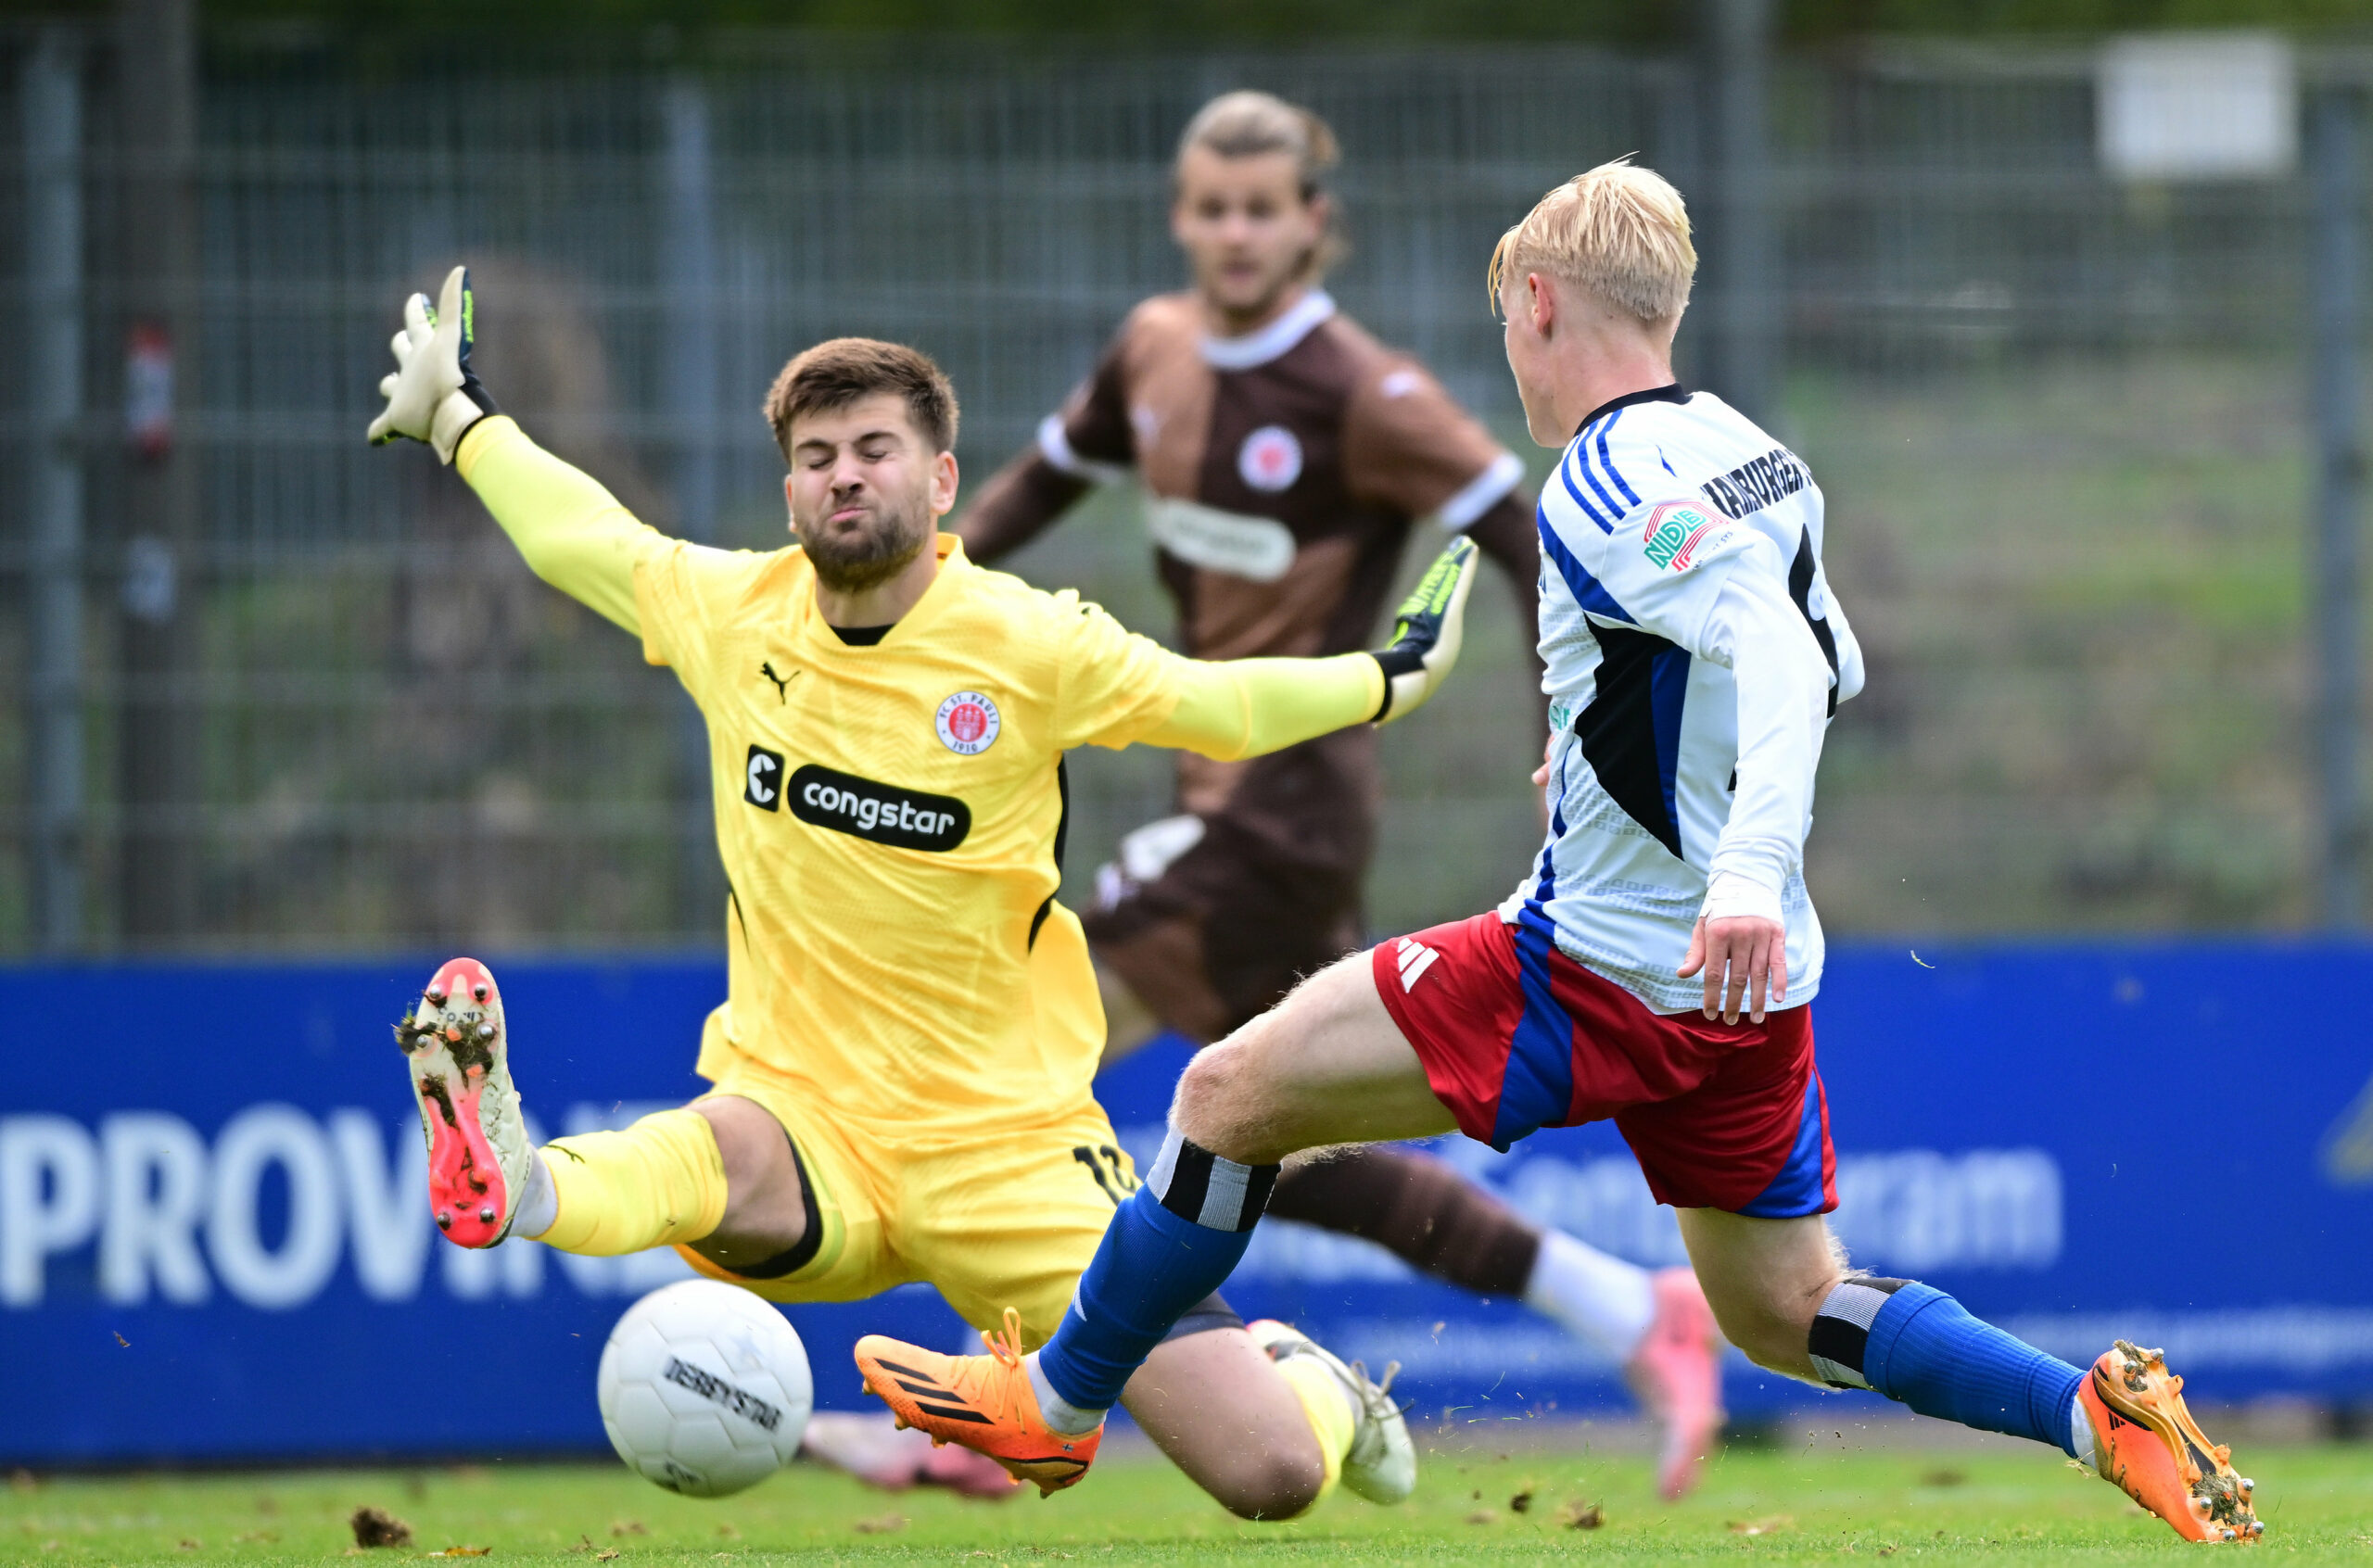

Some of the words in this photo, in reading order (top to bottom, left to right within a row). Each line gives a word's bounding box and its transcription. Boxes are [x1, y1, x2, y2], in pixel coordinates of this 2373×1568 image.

[971, 694, 998, 724] PAULI
[953, 740, 978, 752] 1910
[804, 782, 956, 836] congstar
